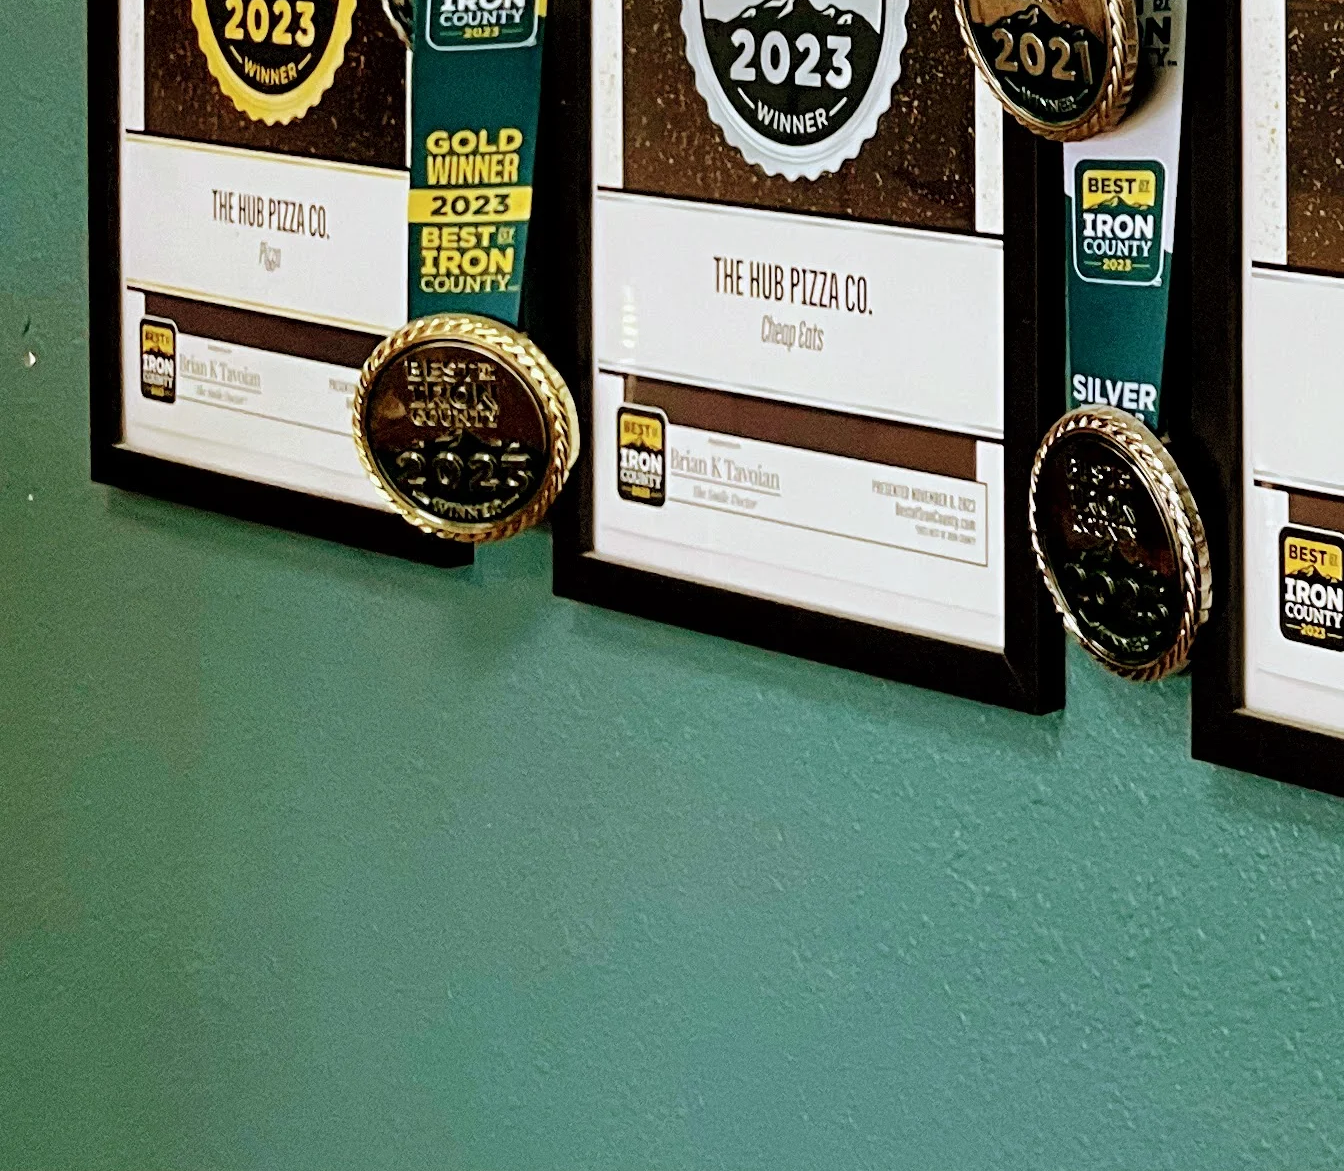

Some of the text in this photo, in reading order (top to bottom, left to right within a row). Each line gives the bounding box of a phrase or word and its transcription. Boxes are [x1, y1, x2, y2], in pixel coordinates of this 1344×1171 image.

[730, 28, 852, 90] 2023
[991, 28, 1093, 85] 2021
[757, 100, 828, 134] WINNER
[426, 129, 523, 155] GOLD
[427, 155, 519, 186] WINNER
[1088, 177, 1136, 194] BEST
[212, 189, 330, 240] THE HUB PIZZA CO.
[431, 195, 510, 217] 2023
[421, 226, 496, 249] BEST
[1083, 213, 1154, 239] IRON
[1083, 239, 1152, 257] COUNTY
[420, 249, 515, 276] IRON
[714, 257, 873, 315] THE HUB PIZZA CO.
[761, 315, 824, 352] Cheap Eats
[1289, 544, 1326, 566] BEST
[1285, 603, 1343, 629] COUNTY
